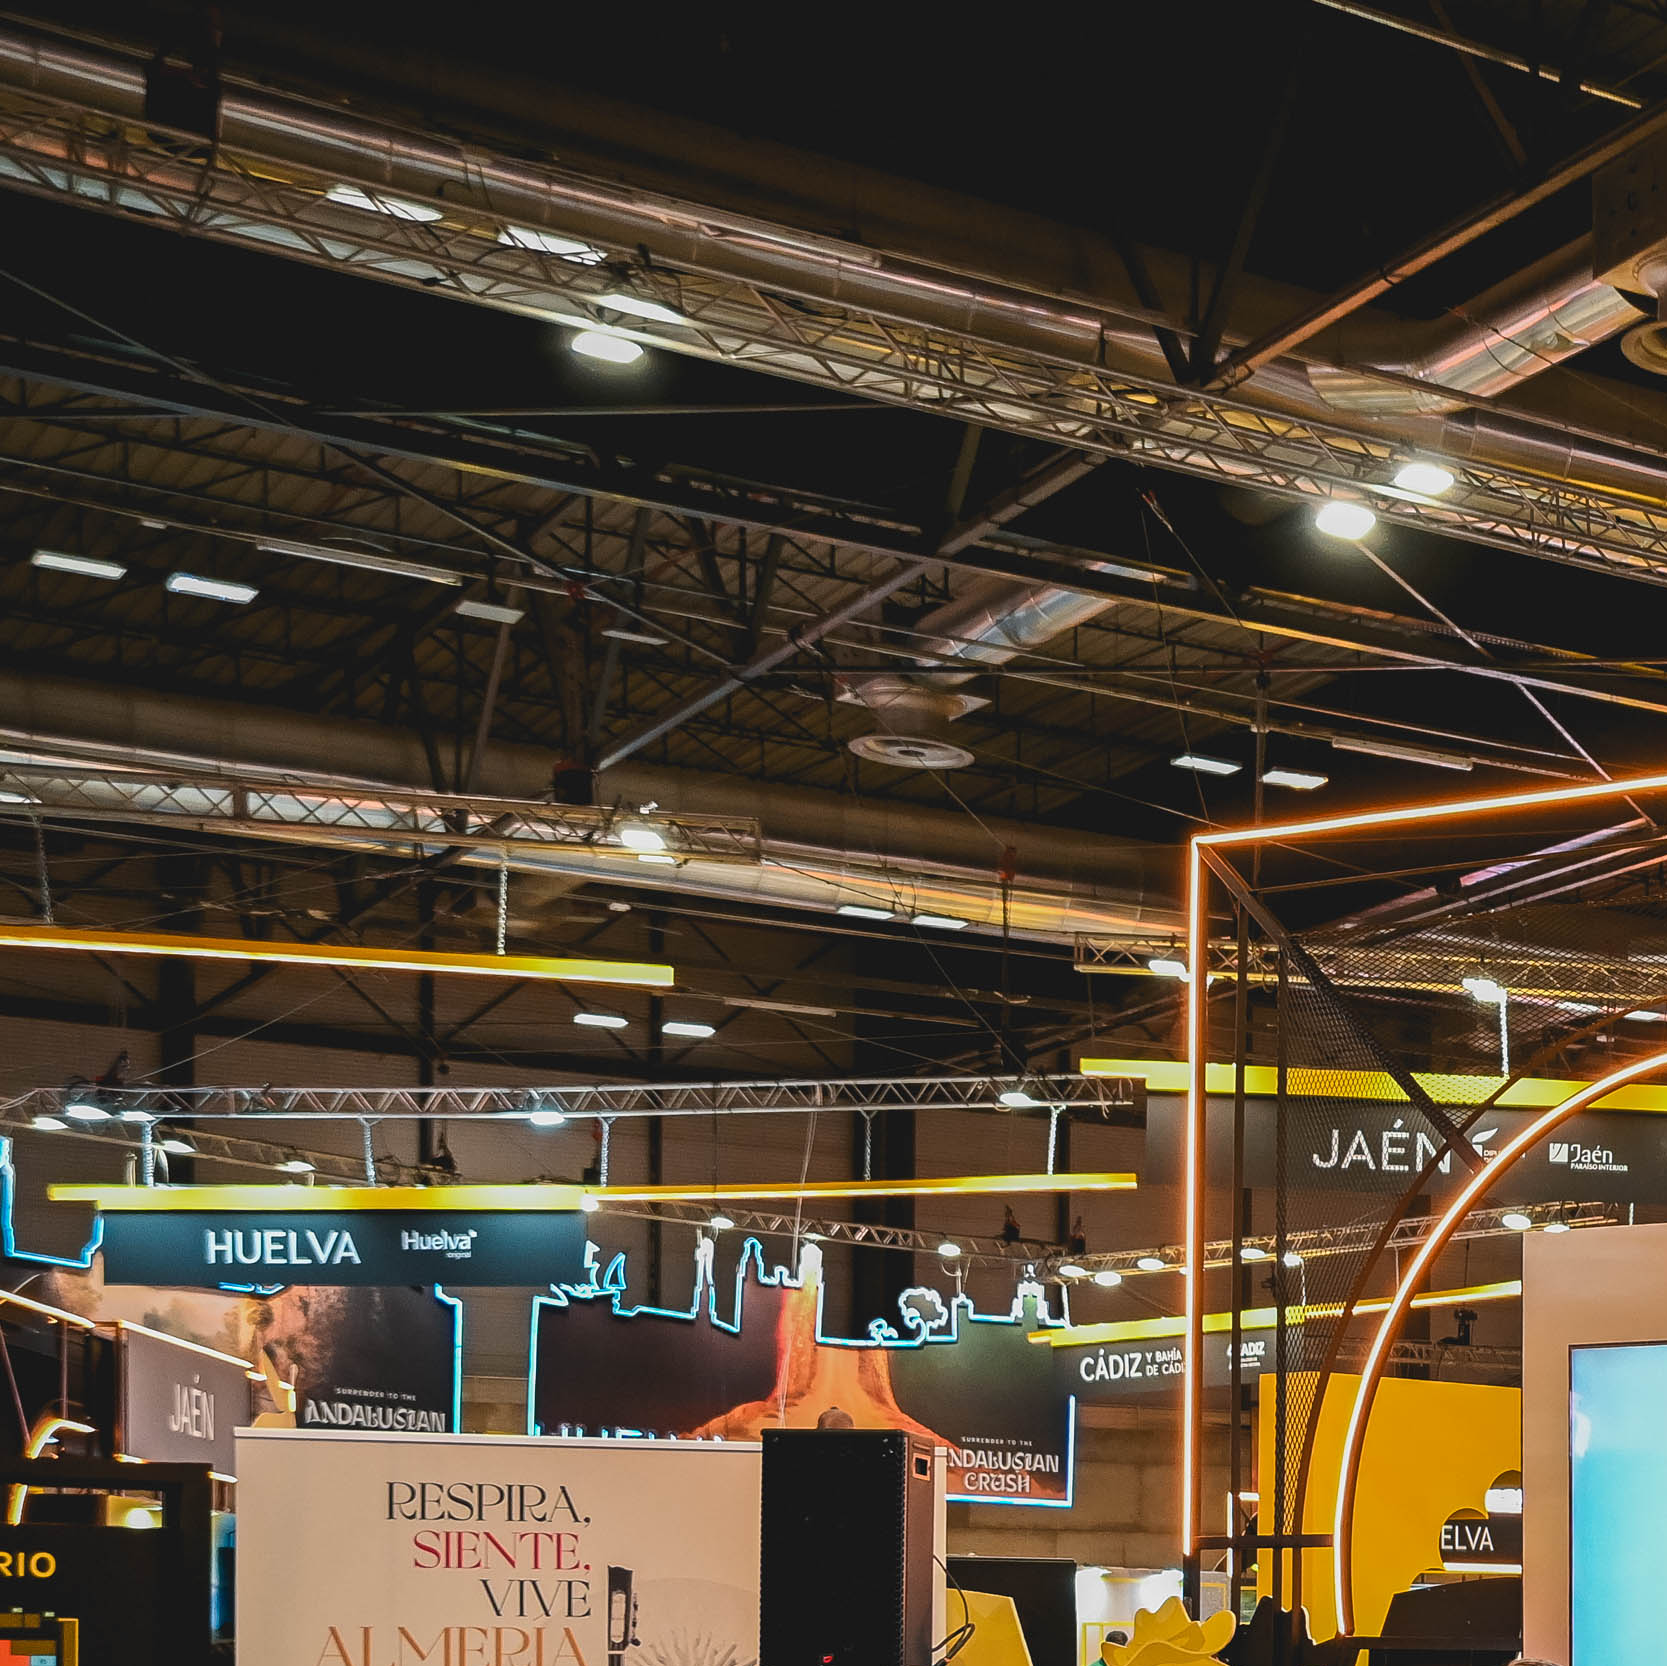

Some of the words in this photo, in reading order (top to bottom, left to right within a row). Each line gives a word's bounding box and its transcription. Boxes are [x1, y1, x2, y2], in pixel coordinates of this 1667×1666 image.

[1312, 1118, 1451, 1174] JAÉN
[1570, 1144, 1613, 1163] Jaén
[205, 1229, 362, 1264] HUELVA
[401, 1229, 472, 1250] Huelva
[1079, 1349, 1143, 1382] CÁDIZ
[1145, 1352, 1154, 1363] Y
[1155, 1347, 1183, 1363] BAHÍA
[1146, 1365, 1159, 1377] DE
[1162, 1359, 1186, 1375] CÁDI
[304, 1399, 446, 1432] ANDALUSIAN
[947, 1448, 1060, 1473] NDALUSIAN
[964, 1472, 1031, 1493] CRUSH
[386, 1481, 591, 1528] RESPIRA,
[413, 1529, 591, 1576] SIENTE,
[1441, 1525, 1495, 1551] ELVA
[479, 1579, 592, 1618] VIVE
